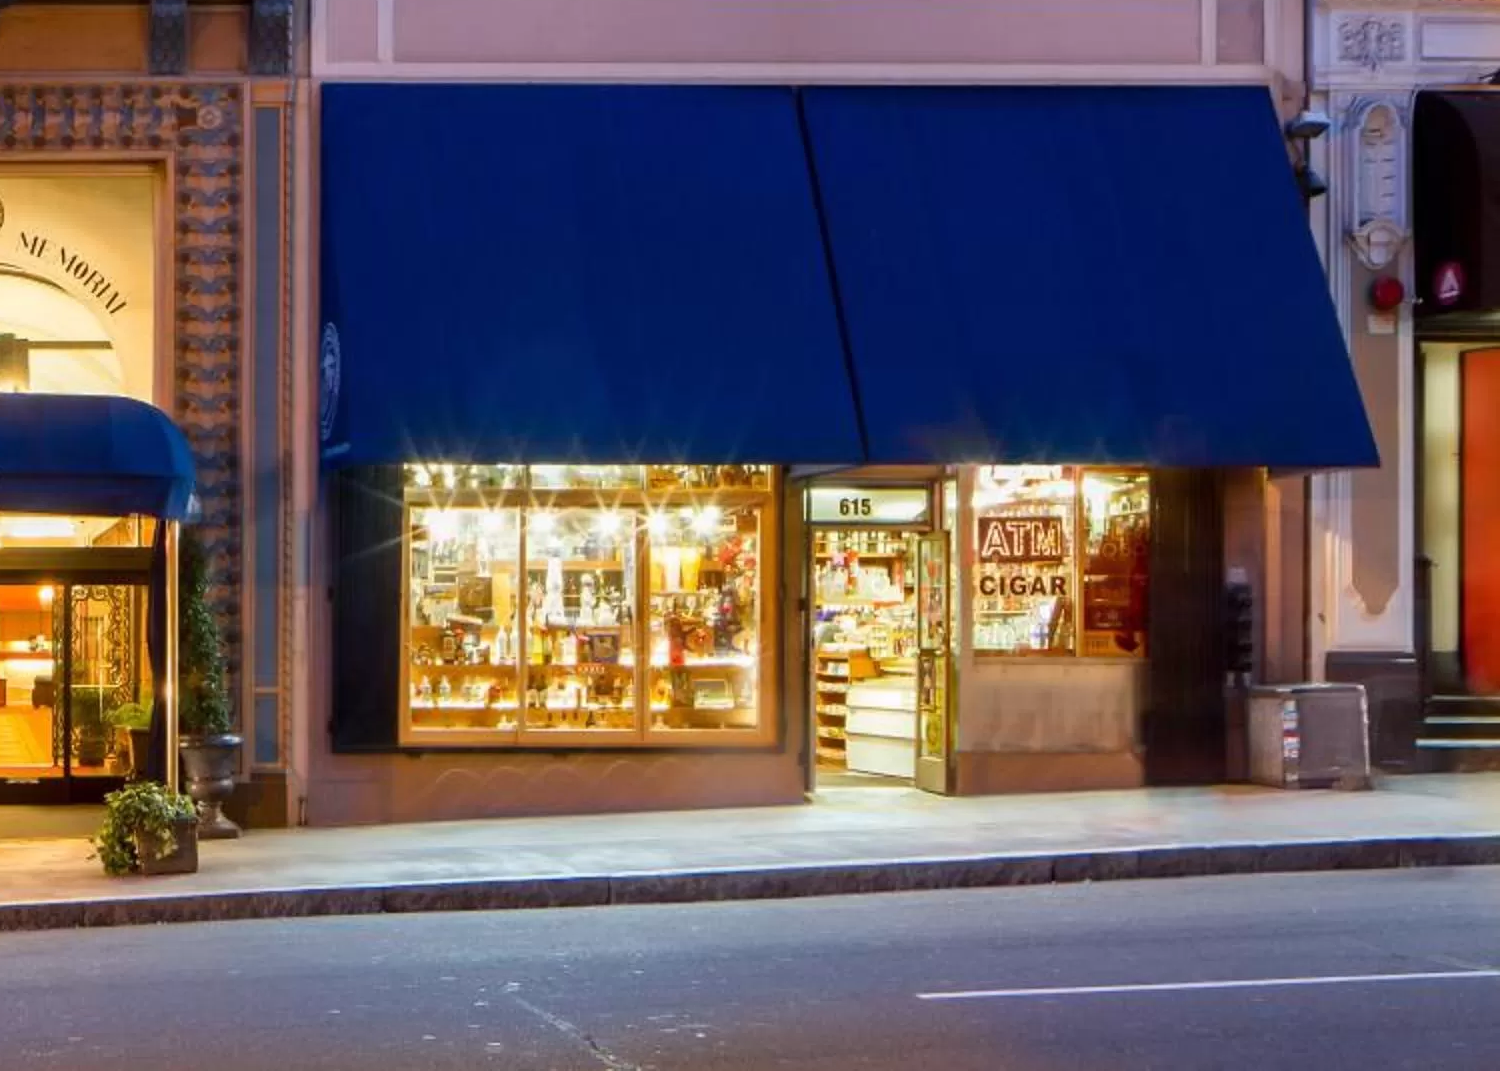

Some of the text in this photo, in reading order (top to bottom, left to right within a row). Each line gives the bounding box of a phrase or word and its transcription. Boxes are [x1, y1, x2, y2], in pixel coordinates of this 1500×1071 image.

[839, 497, 872, 516] 615
[981, 520, 1062, 557] ATM
[979, 575, 1067, 596] CIGAR
